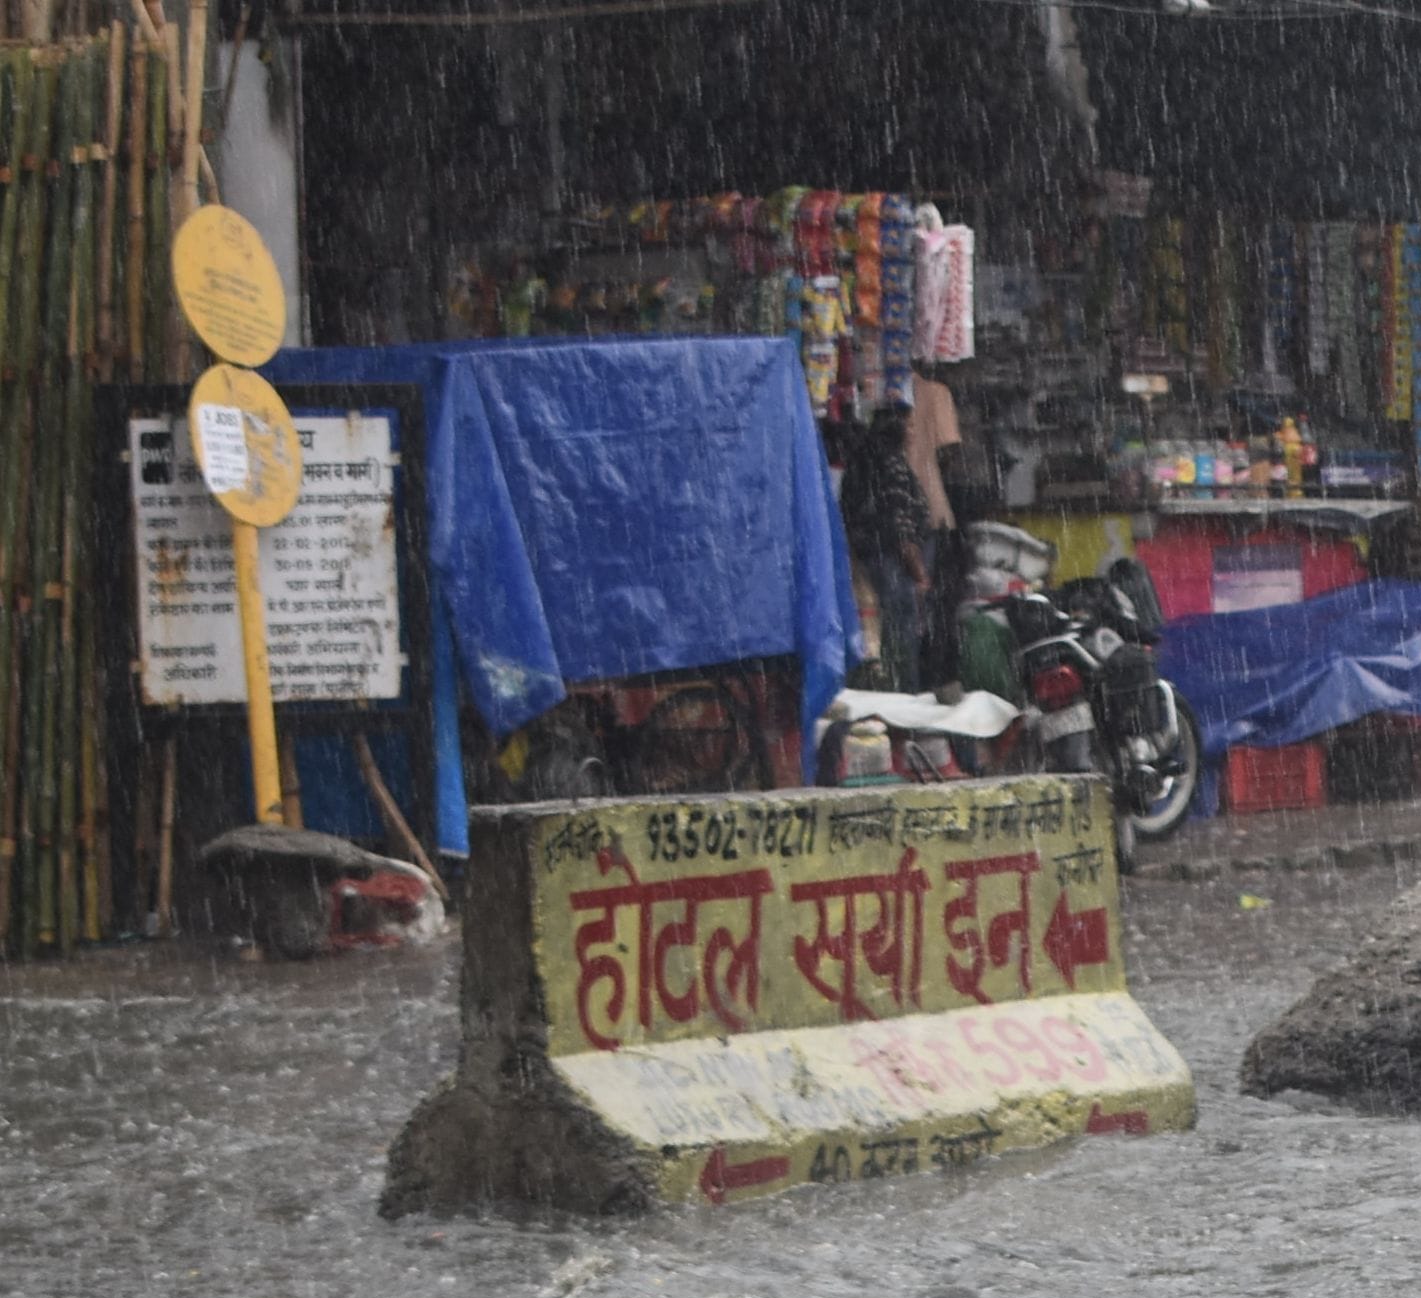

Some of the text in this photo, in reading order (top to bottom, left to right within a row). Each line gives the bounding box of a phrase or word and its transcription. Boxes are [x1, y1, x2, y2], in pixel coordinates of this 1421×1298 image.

[570, 846, 775, 1053] होटल
[945, 850, 1042, 1005] इन
[956, 1015, 1109, 1087] 599
